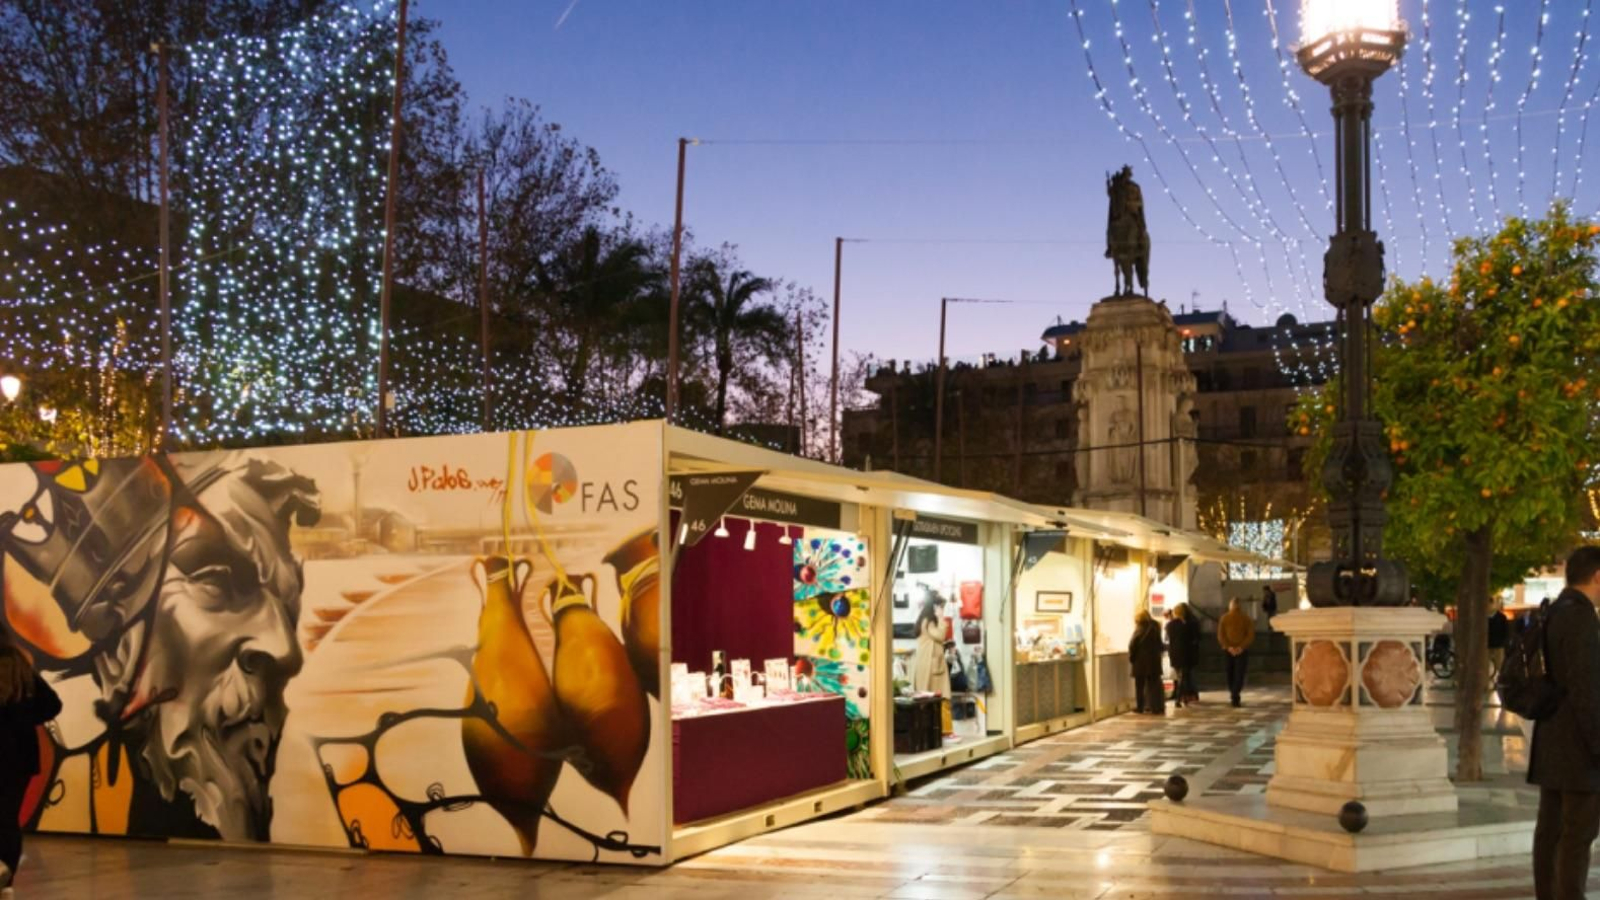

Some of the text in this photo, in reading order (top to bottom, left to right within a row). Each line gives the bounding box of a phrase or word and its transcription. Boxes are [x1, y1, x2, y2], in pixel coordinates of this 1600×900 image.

[581, 479, 639, 512] FAS
[669, 481, 683, 499] 46
[768, 498, 798, 516] MOLINA
[690, 519, 706, 532] 46
